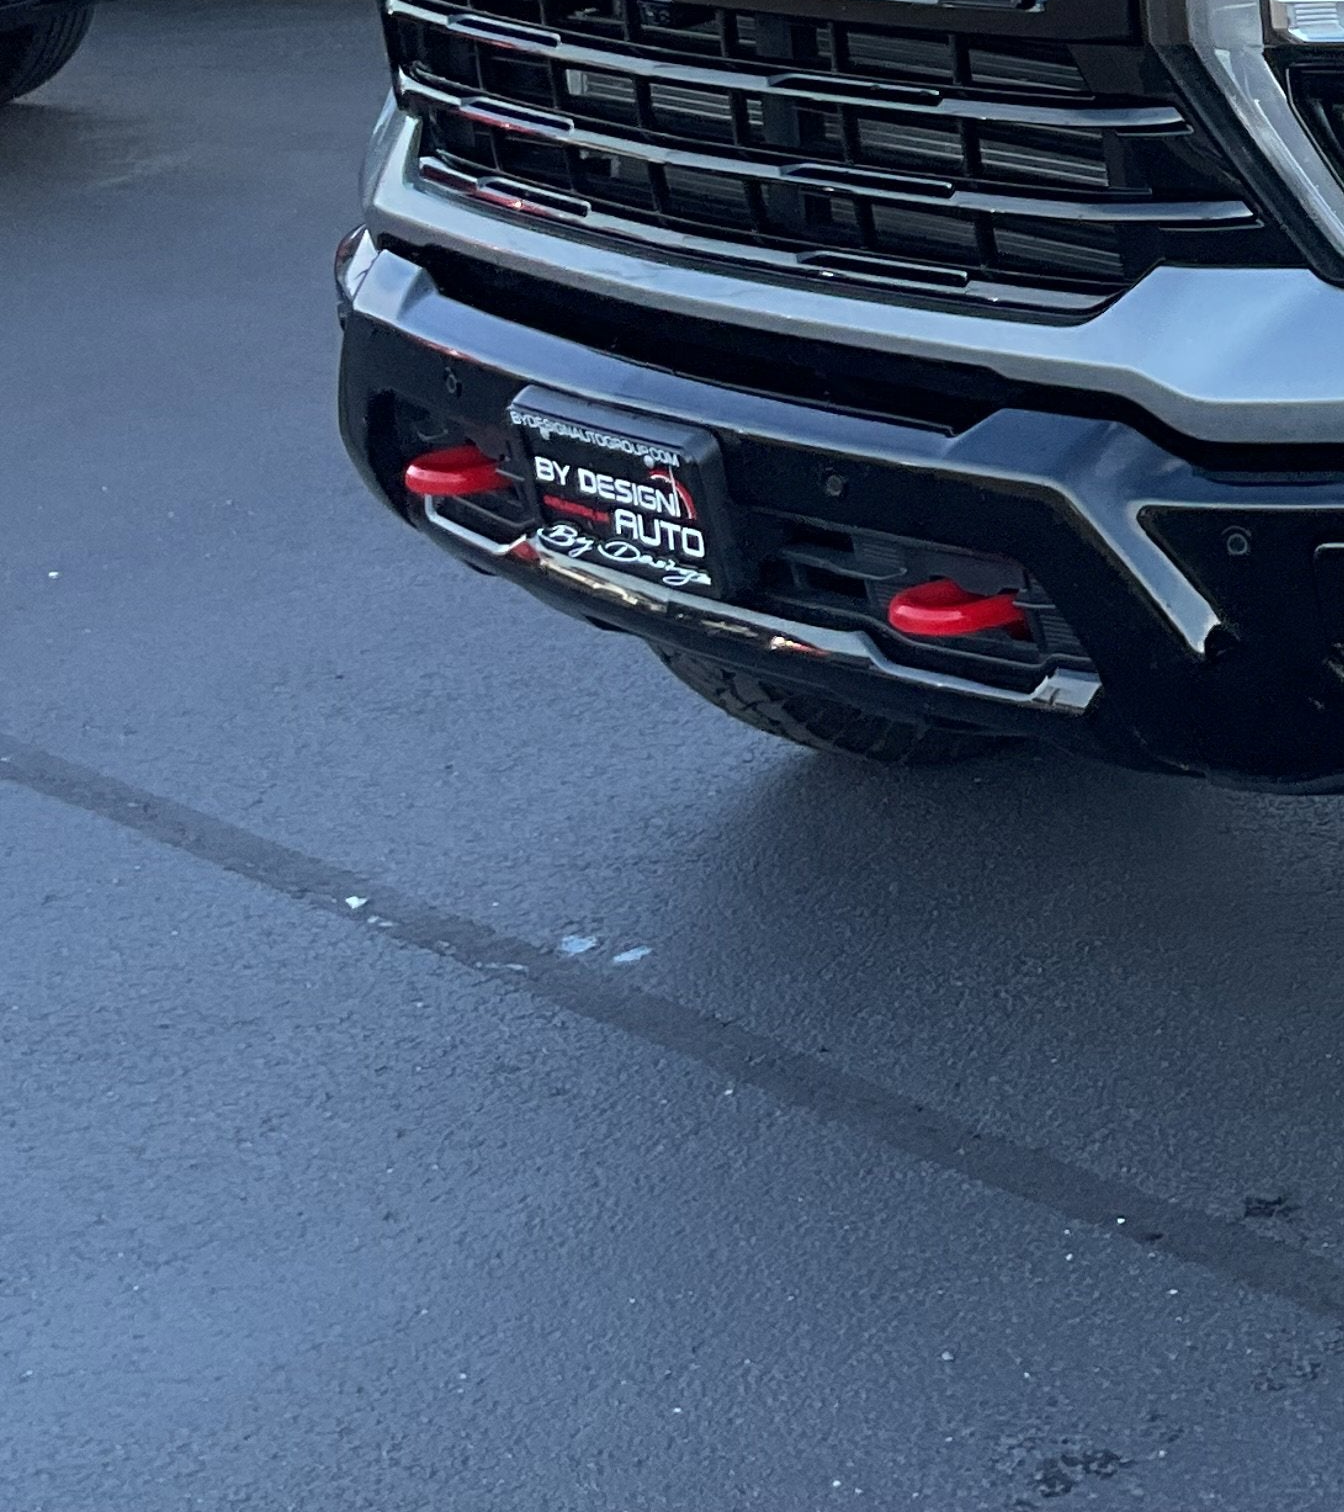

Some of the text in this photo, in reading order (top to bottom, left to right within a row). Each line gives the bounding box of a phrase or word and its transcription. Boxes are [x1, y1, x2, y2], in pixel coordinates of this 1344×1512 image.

[535, 456, 570, 486] BY
[577, 467, 681, 518] DESIGN
[614, 508, 705, 559] AUTO
